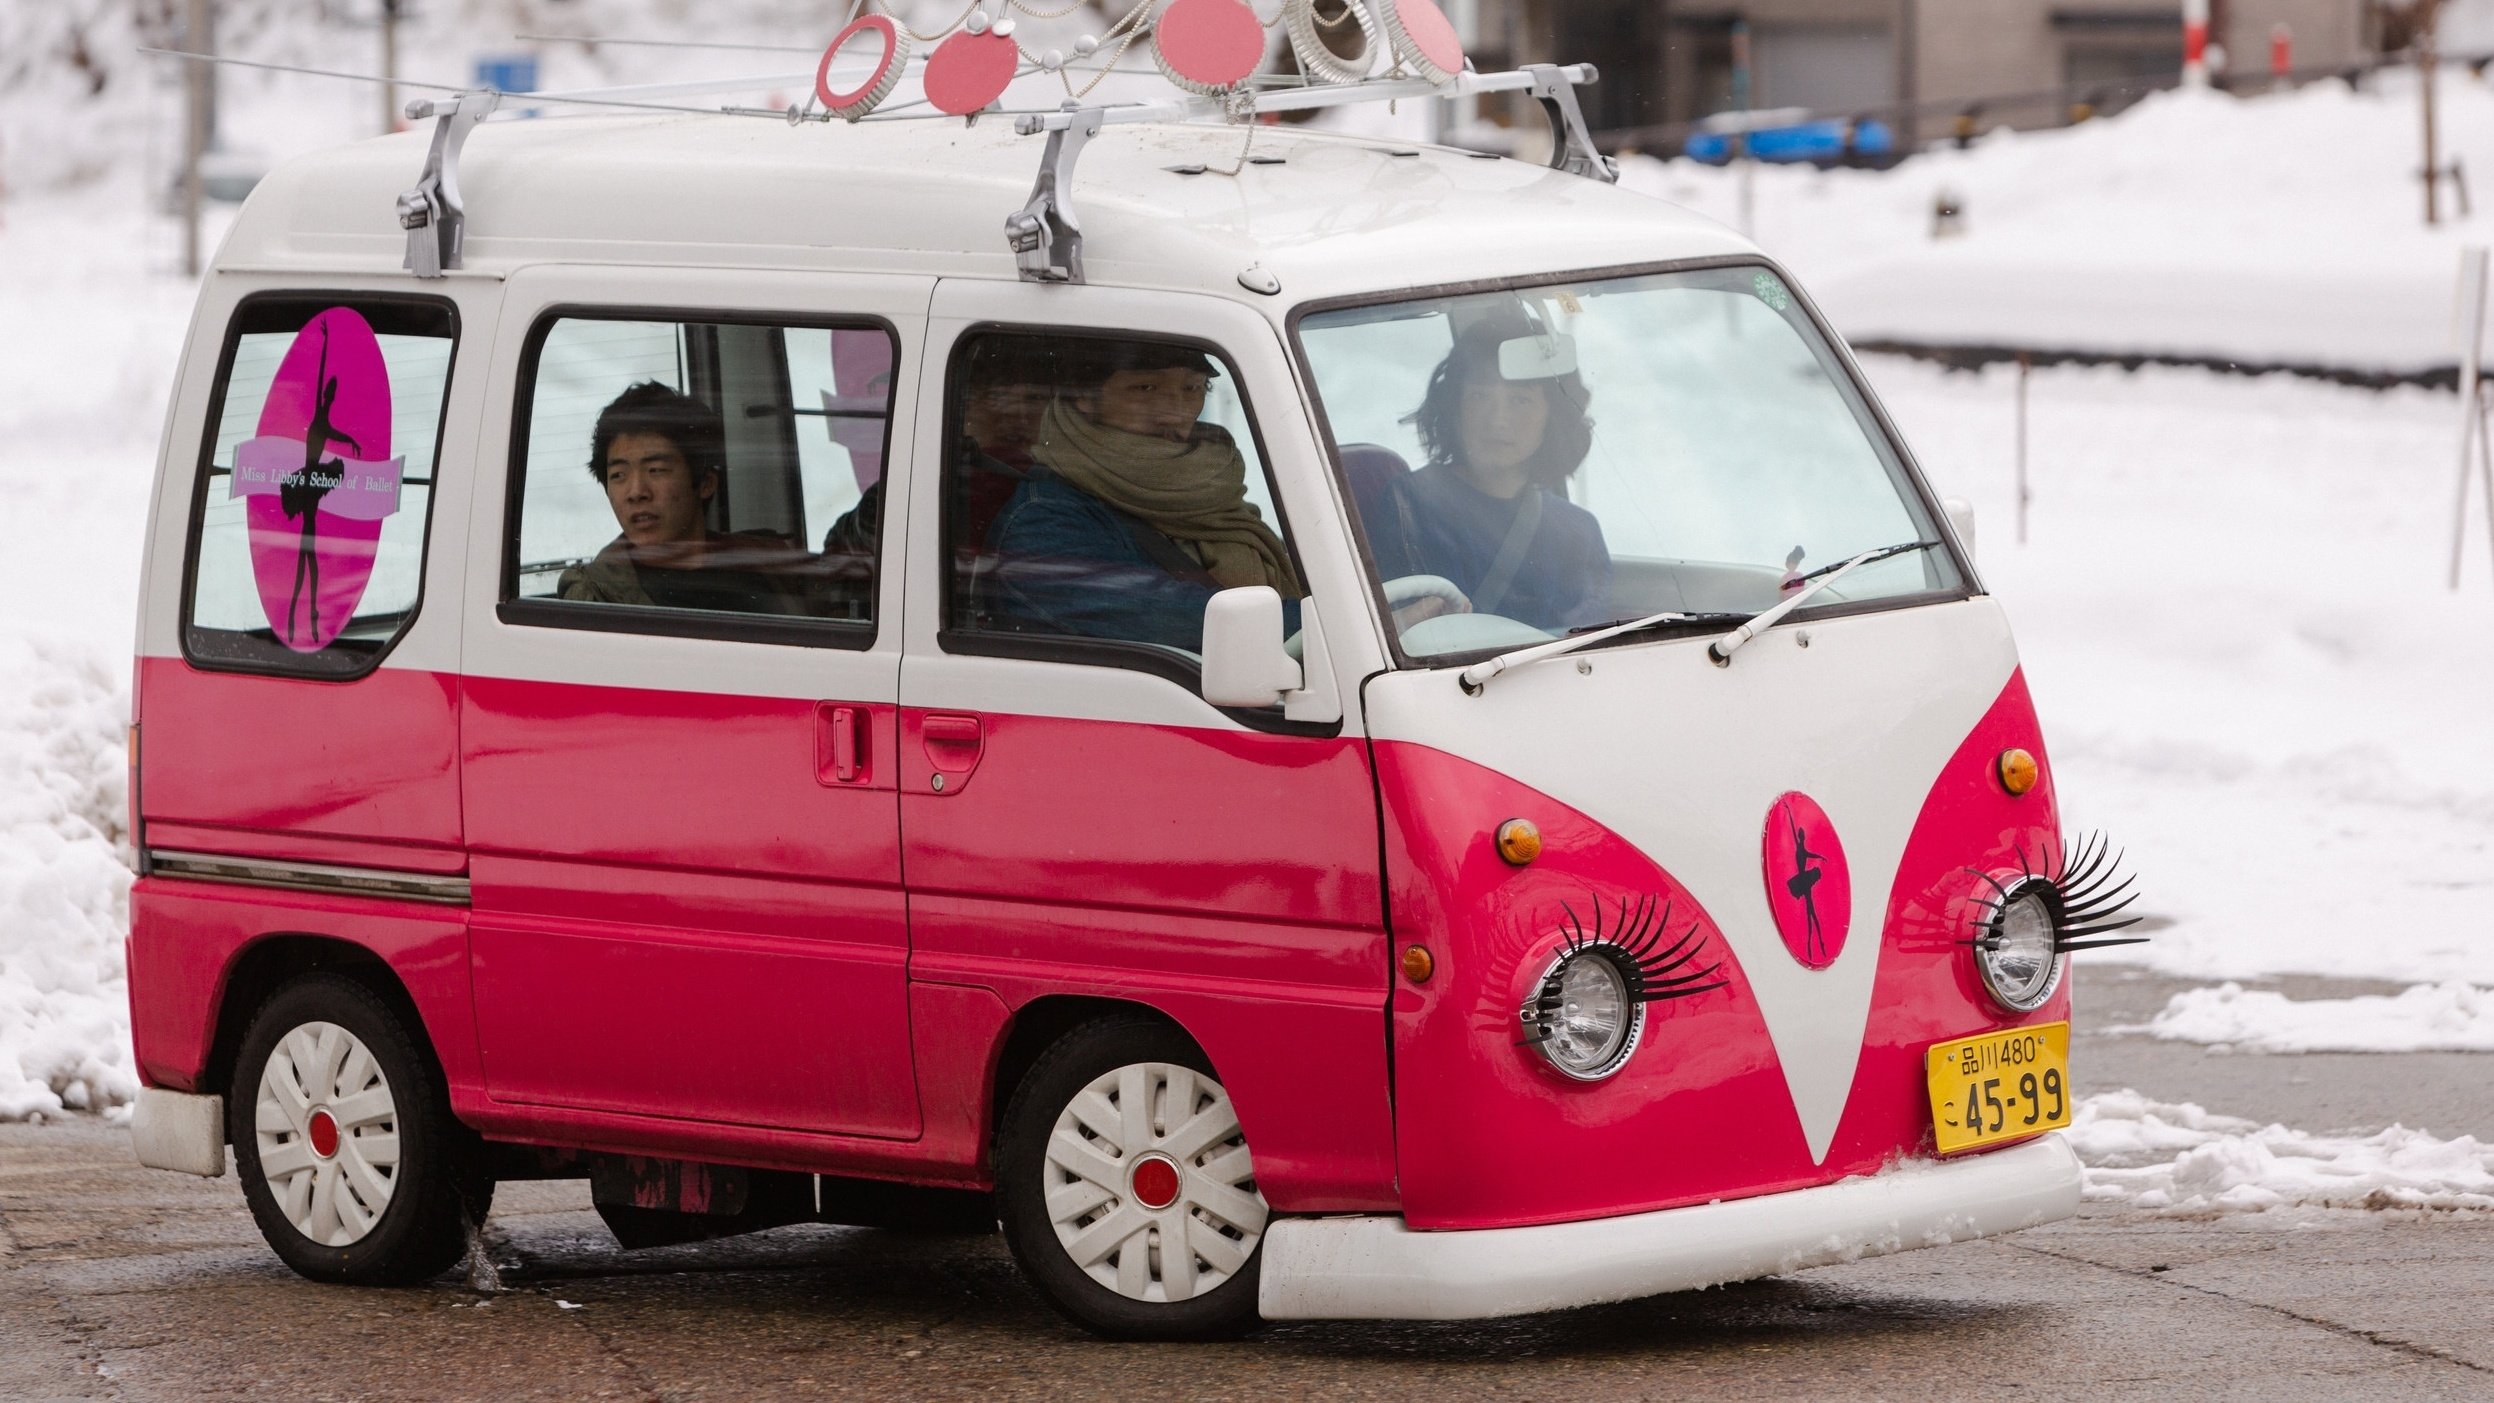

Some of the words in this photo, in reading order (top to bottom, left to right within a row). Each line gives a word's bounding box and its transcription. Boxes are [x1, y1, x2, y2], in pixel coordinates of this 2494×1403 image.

[240, 466, 266, 482] Miss
[271, 468, 305, 488] Libby's
[309, 471, 342, 488] School
[347, 475, 359, 490] of
[365, 476, 393, 493] Ballet
[1944, 1101, 1958, 1126] こ
[1966, 1068, 2063, 1136] 45-99
